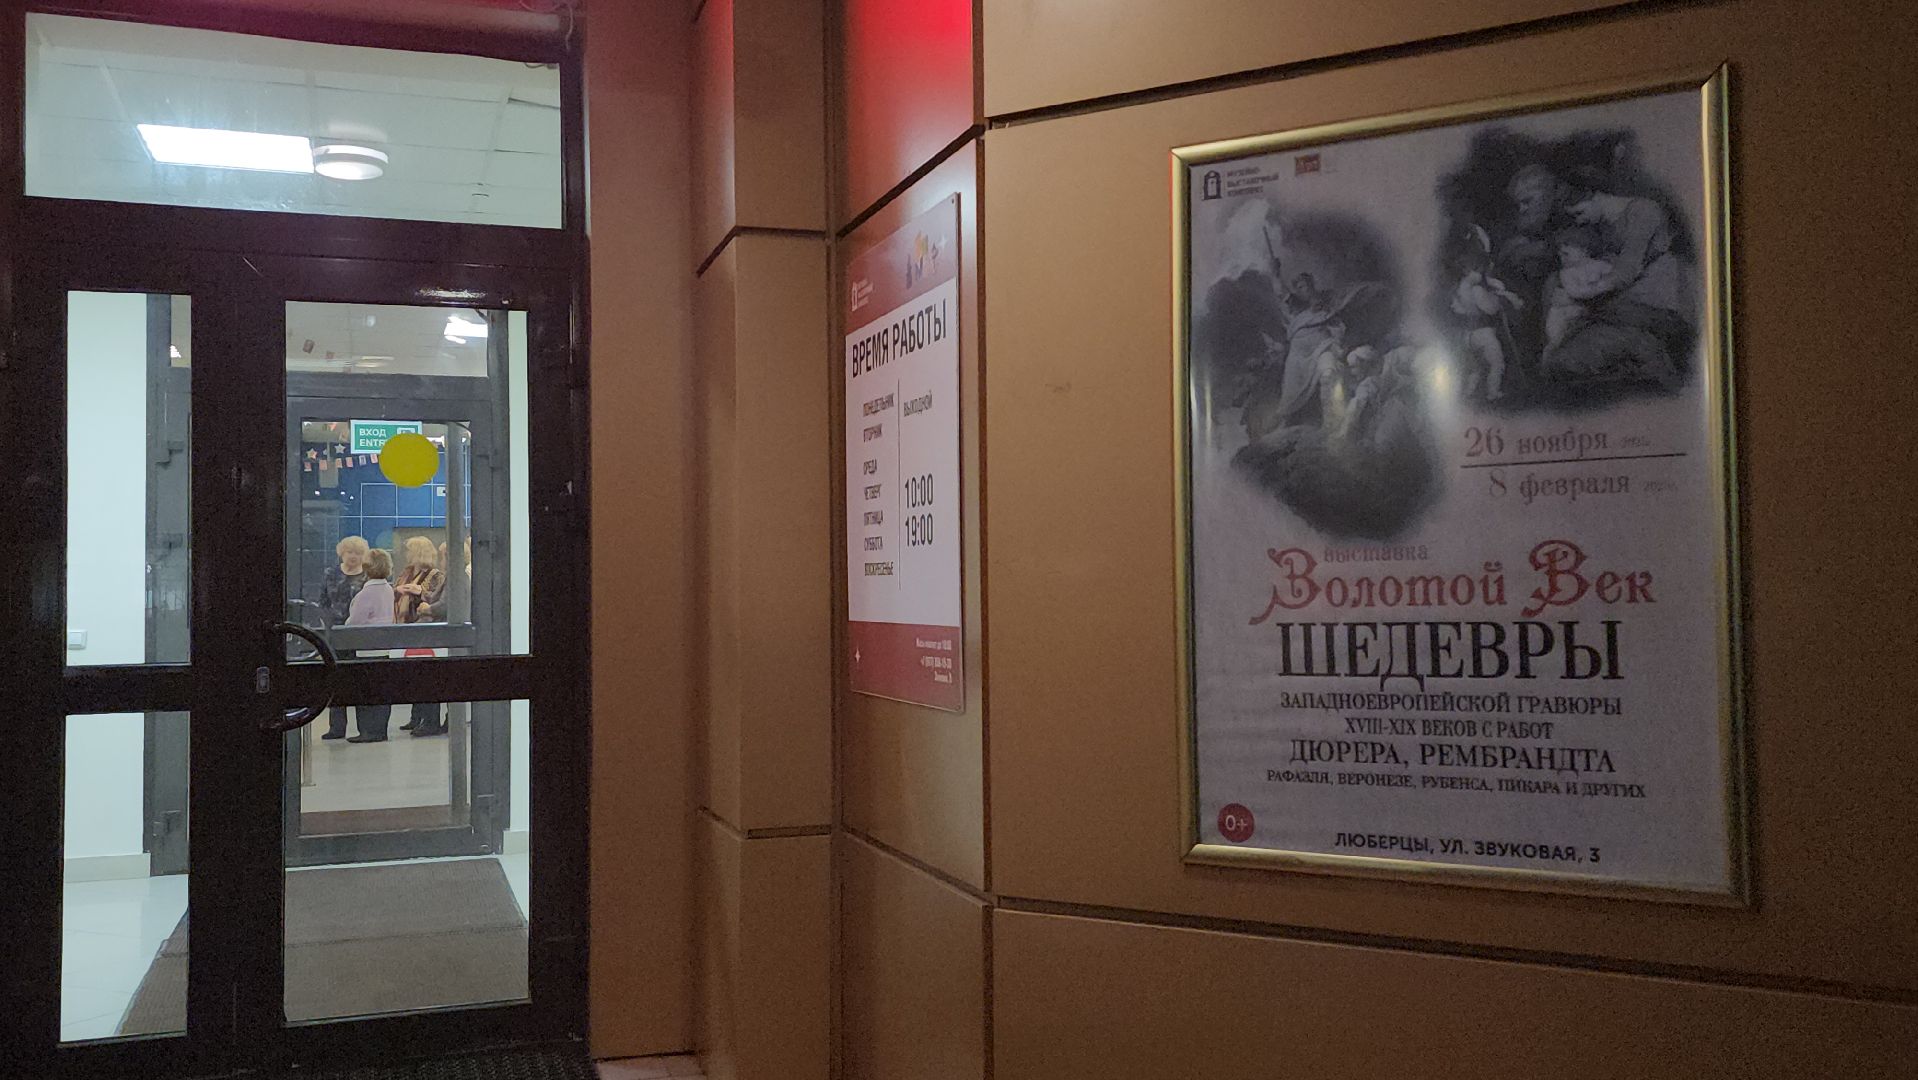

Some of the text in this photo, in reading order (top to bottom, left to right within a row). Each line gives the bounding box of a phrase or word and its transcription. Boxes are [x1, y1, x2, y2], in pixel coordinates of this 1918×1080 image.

[852, 297, 947, 378] ВРЕМЯ РАБОТЫ
[359, 428, 387, 438] ВХОД
[359, 438, 387, 447] ENTR
[1464, 427, 1505, 457] 26
[1517, 427, 1608, 457] ноября
[904, 473, 934, 509] 10:00
[1488, 468, 1508, 498] 8
[1519, 473, 1630, 505] февраля
[904, 512, 934, 548] 19:00
[1520, 539, 1657, 617] Век
[1276, 620, 1625, 692] ШЕДЕВРЫ
[1281, 691, 1622, 715] ЗАПАДНОЕВРОПЕЙСКОЙ ГРАВЮРЫ
[1344, 717, 1554, 739] XVIII-XIX ВЕКОВ С РАБОТ
[1289, 739, 1616, 776] ДЮРЕРА, РЕМБРАНДТА
[1338, 772, 1417, 789] ВЕРОНЕЗЕ,
[1421, 776, 1493, 792] РУБЕНСА,
[1499, 778, 1560, 794] ПИКАРА
[1566, 782, 1577, 795] И
[1582, 782, 1646, 798] ДРУГИХ
[1224, 814, 1248, 831] 0+
[1334, 832, 1601, 863] ЛЮБЕРЦЫ, УЛ. ЗВУКОВАЯ, 3
